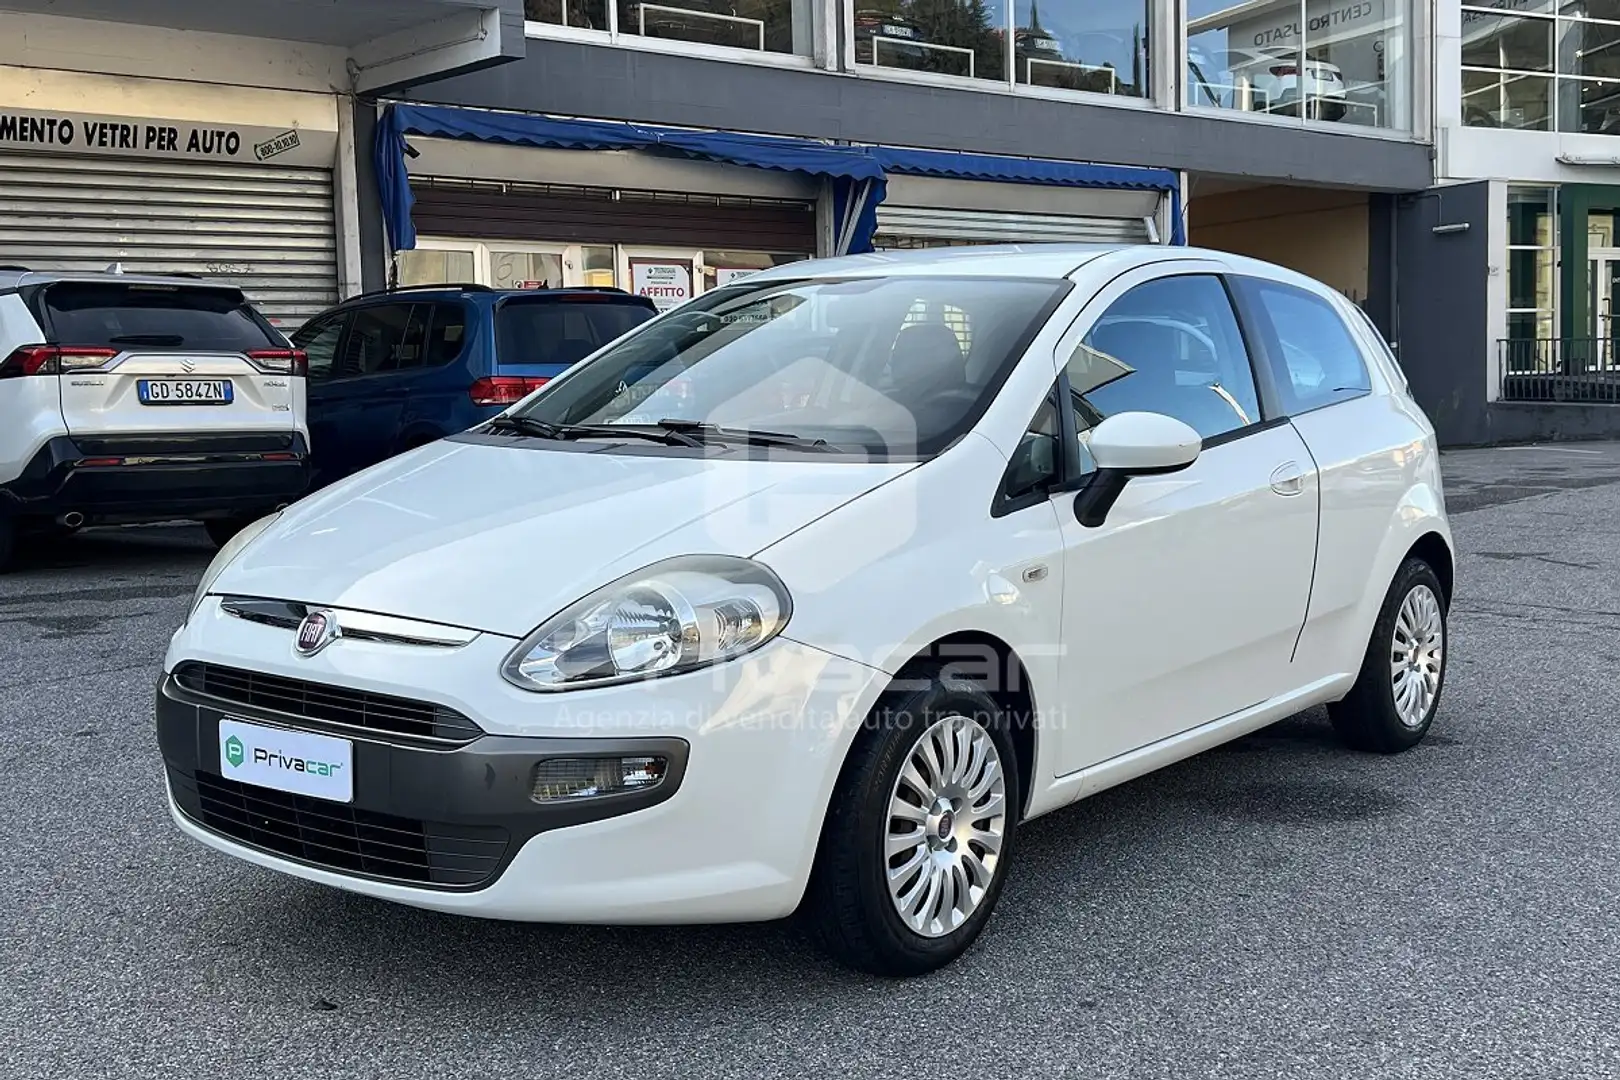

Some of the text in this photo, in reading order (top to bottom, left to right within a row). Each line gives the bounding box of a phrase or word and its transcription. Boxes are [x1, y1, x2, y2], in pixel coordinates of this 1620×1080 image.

[0, 115, 240, 155] MENTO VETRI PER AUTO
[640, 287, 684, 297] AFFITTO
[150, 382, 223, 398] GD 584ZN
[301, 622, 323, 643] FIAT
[253, 747, 343, 777] Privacar
